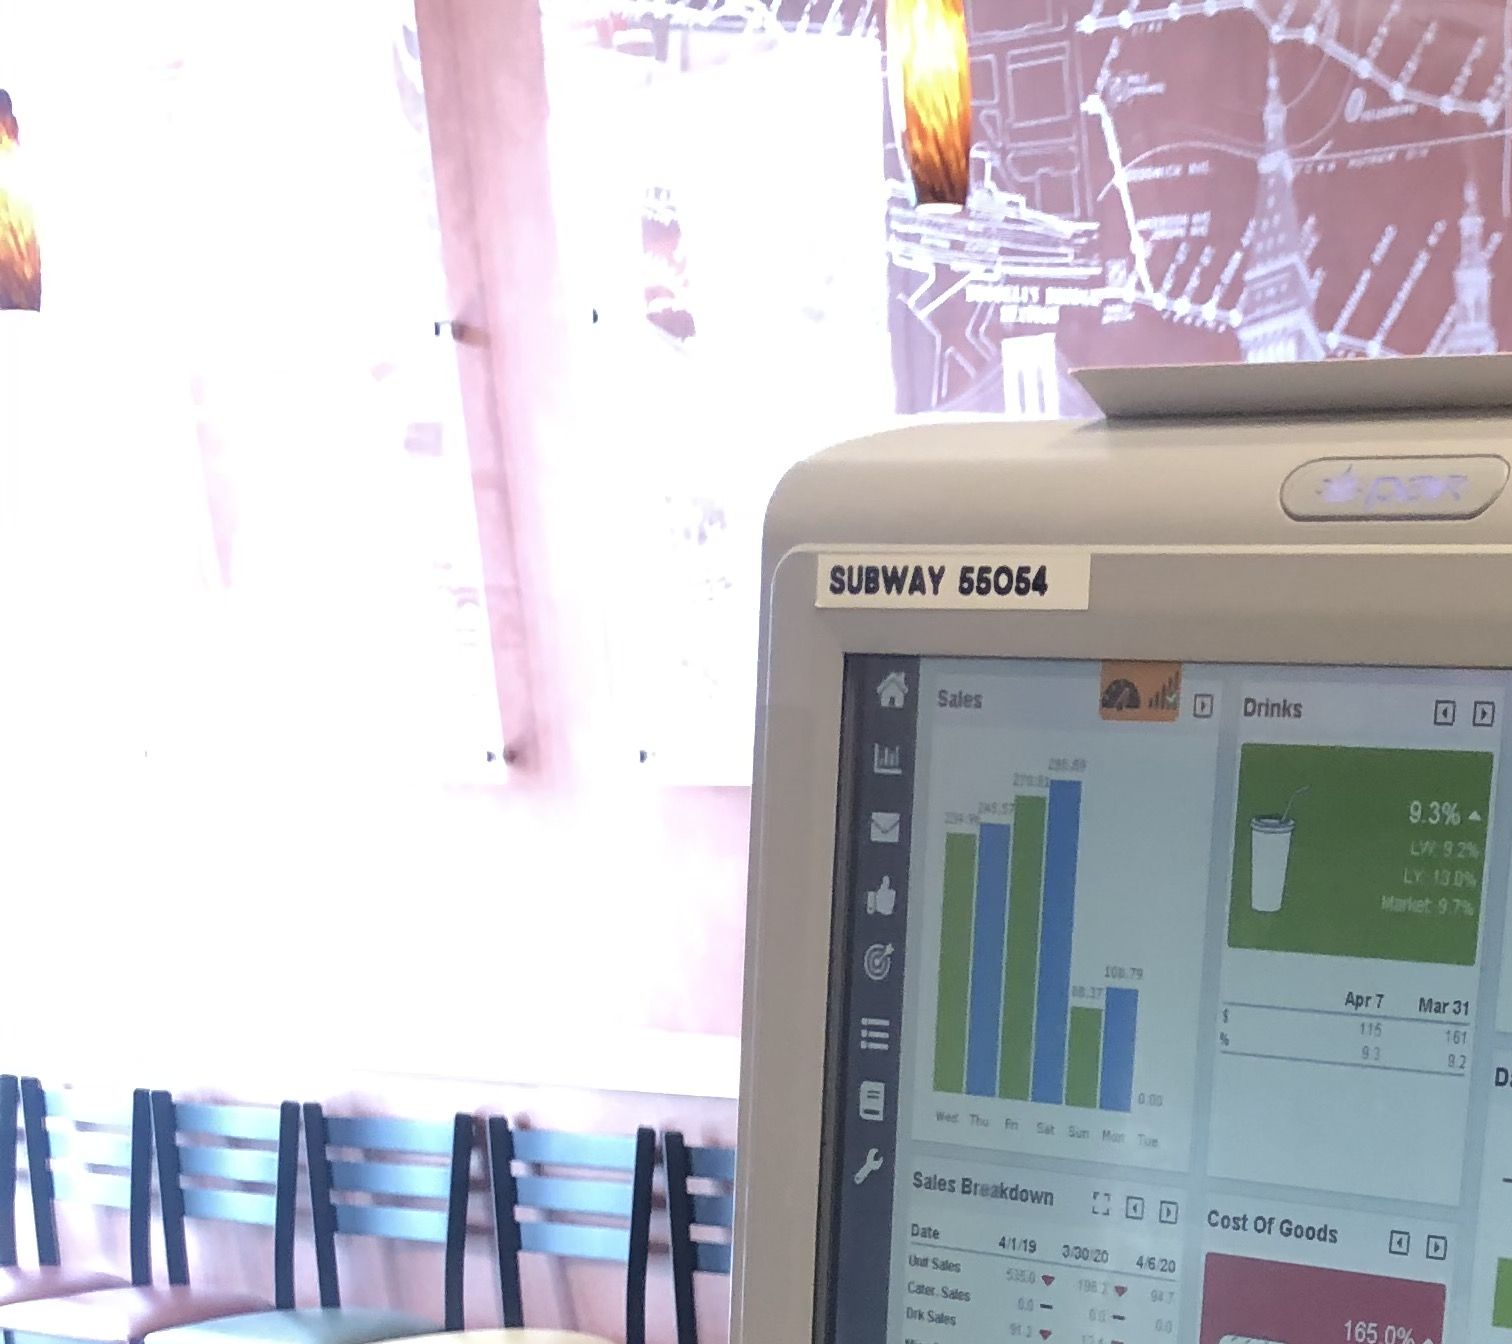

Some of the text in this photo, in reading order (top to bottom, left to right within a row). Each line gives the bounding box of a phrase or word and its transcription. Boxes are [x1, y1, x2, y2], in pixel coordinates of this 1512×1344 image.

[829, 564, 1048, 597] SUBWAY 55054
[937, 689, 983, 710] Sales
[1243, 697, 1303, 720] Drinks
[1409, 800, 1461, 826] 9.3%
[1344, 991, 1385, 1011] Apr 7
[1418, 997, 1470, 1018] Mar 31
[969, 1114, 990, 1129] Thu
[1004, 1119, 1019, 1131] Fri
[1036, 1121, 1056, 1136] Sat
[1068, 1127, 1091, 1141] Sun
[1102, 1130, 1125, 1144] Mon
[1137, 1135, 1159, 1149] Tue
[912, 1170, 1055, 1207] Sales Breakdown
[1207, 1209, 1338, 1245] Cost Of Goods
[911, 1221, 1177, 1275] Date 4/1/19 3/30/20 4/6/20
[931, 1256, 962, 1274] Sales
[940, 1285, 972, 1303] Sales
[927, 1309, 957, 1327] Sales
